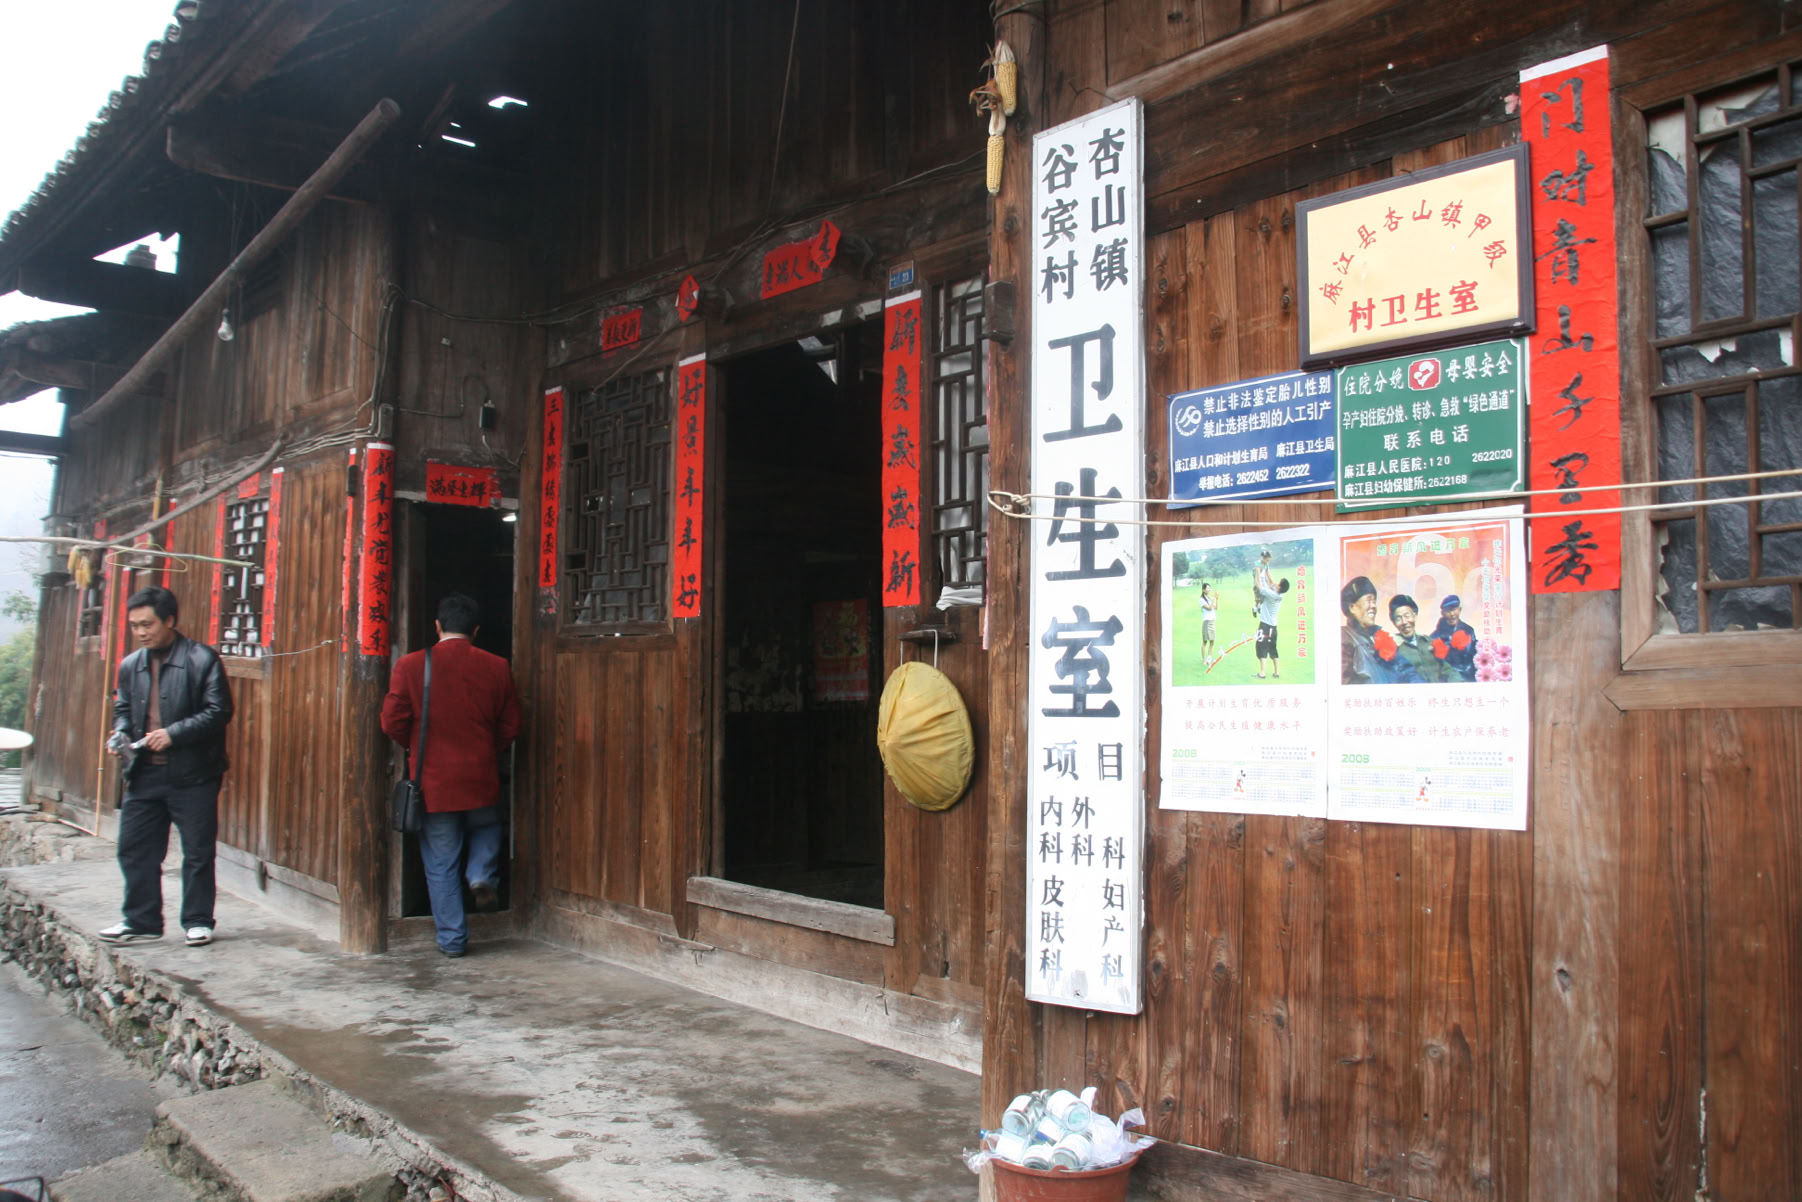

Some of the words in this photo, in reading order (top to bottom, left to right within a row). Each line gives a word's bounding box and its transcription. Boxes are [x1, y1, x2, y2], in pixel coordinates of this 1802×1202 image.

[1041, 143, 1078, 304] 谷宾村
[1089, 128, 1128, 291] 杏山镇
[1319, 200, 1507, 305] 麻江县杏山镇甲级
[1348, 280, 1479, 333] 村卫生室
[1344, 367, 1404, 396] 住院分娩
[1445, 351, 1512, 383] 母婴安全
[1203, 375, 1331, 415] 禁止非法鉴定胎儿性别
[1203, 400, 1332, 438] 禁止选择性别的人工引产
[1383, 424, 1470, 452] 联系电话
[1174, 446, 1268, 473] 麻江县人口和计划生育局
[1276, 436, 1334, 458] 麻江县卫生局
[1275, 463, 1310, 480] 2622322
[1471, 448, 1513, 463] 2622020
[1041, 323, 1127, 718] 卫生室
[1185, 697, 1302, 709] 开展计划生育优质服务
[1184, 719, 1302, 731] 提高公民生殖健康水平
[1043, 740, 1123, 781] 项目
[1172, 748, 1197, 758] 2008
[1341, 753, 1370, 764] 2008
[1039, 795, 1063, 864] 内科
[1071, 796, 1096, 867] 外科
[1039, 875, 1064, 981] 皮肤科
[1101, 879, 1125, 985] 妇产科
